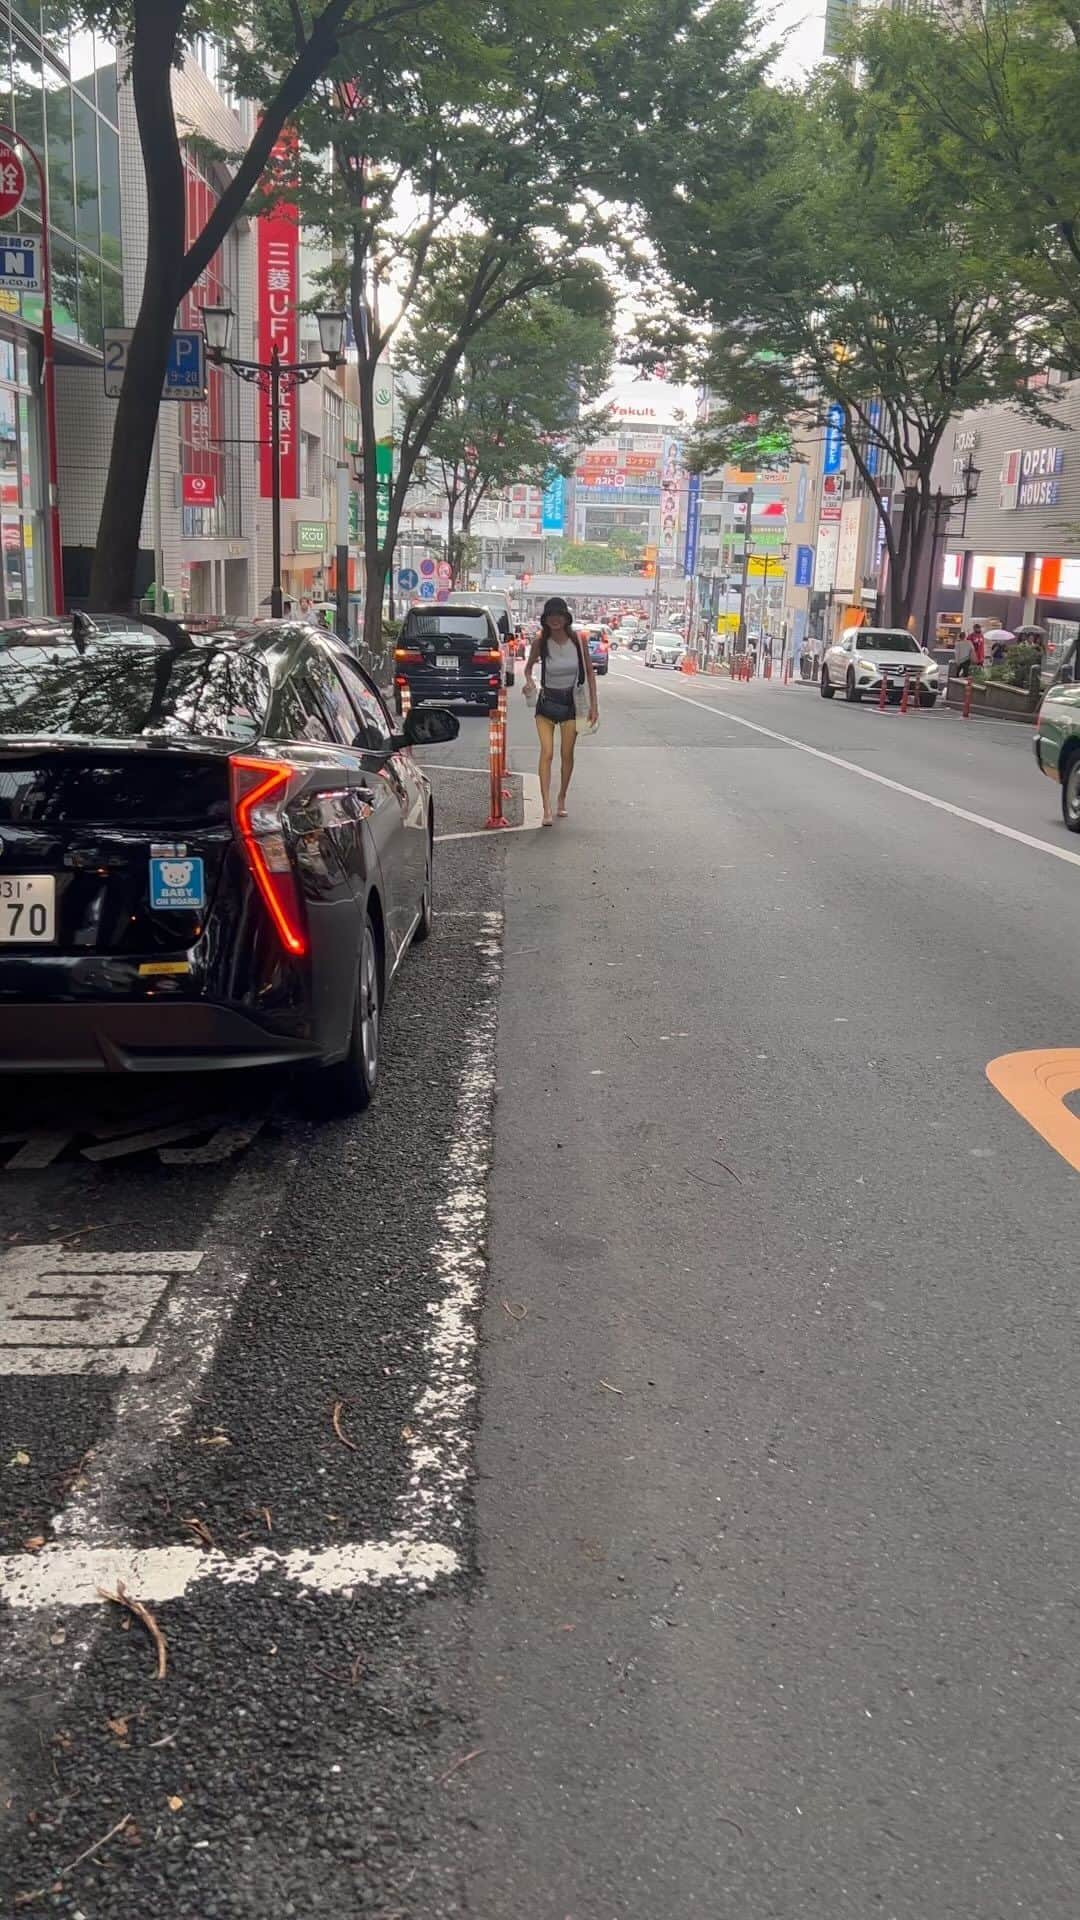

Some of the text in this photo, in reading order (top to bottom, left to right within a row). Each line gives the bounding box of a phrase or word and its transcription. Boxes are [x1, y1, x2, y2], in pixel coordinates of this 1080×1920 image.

[176, 339, 192, 366] P
[609, 403, 656, 416] Yakult
[1023, 448, 1057, 475] OPEN
[1020, 481, 1053, 505] HOUSE
[302, 532, 324, 541] KOU
[0, 881, 21, 898] 31
[161, 888, 193, 898] BABY
[156, 898, 200, 906] ON BOARD
[7, 903, 47, 936] 70
